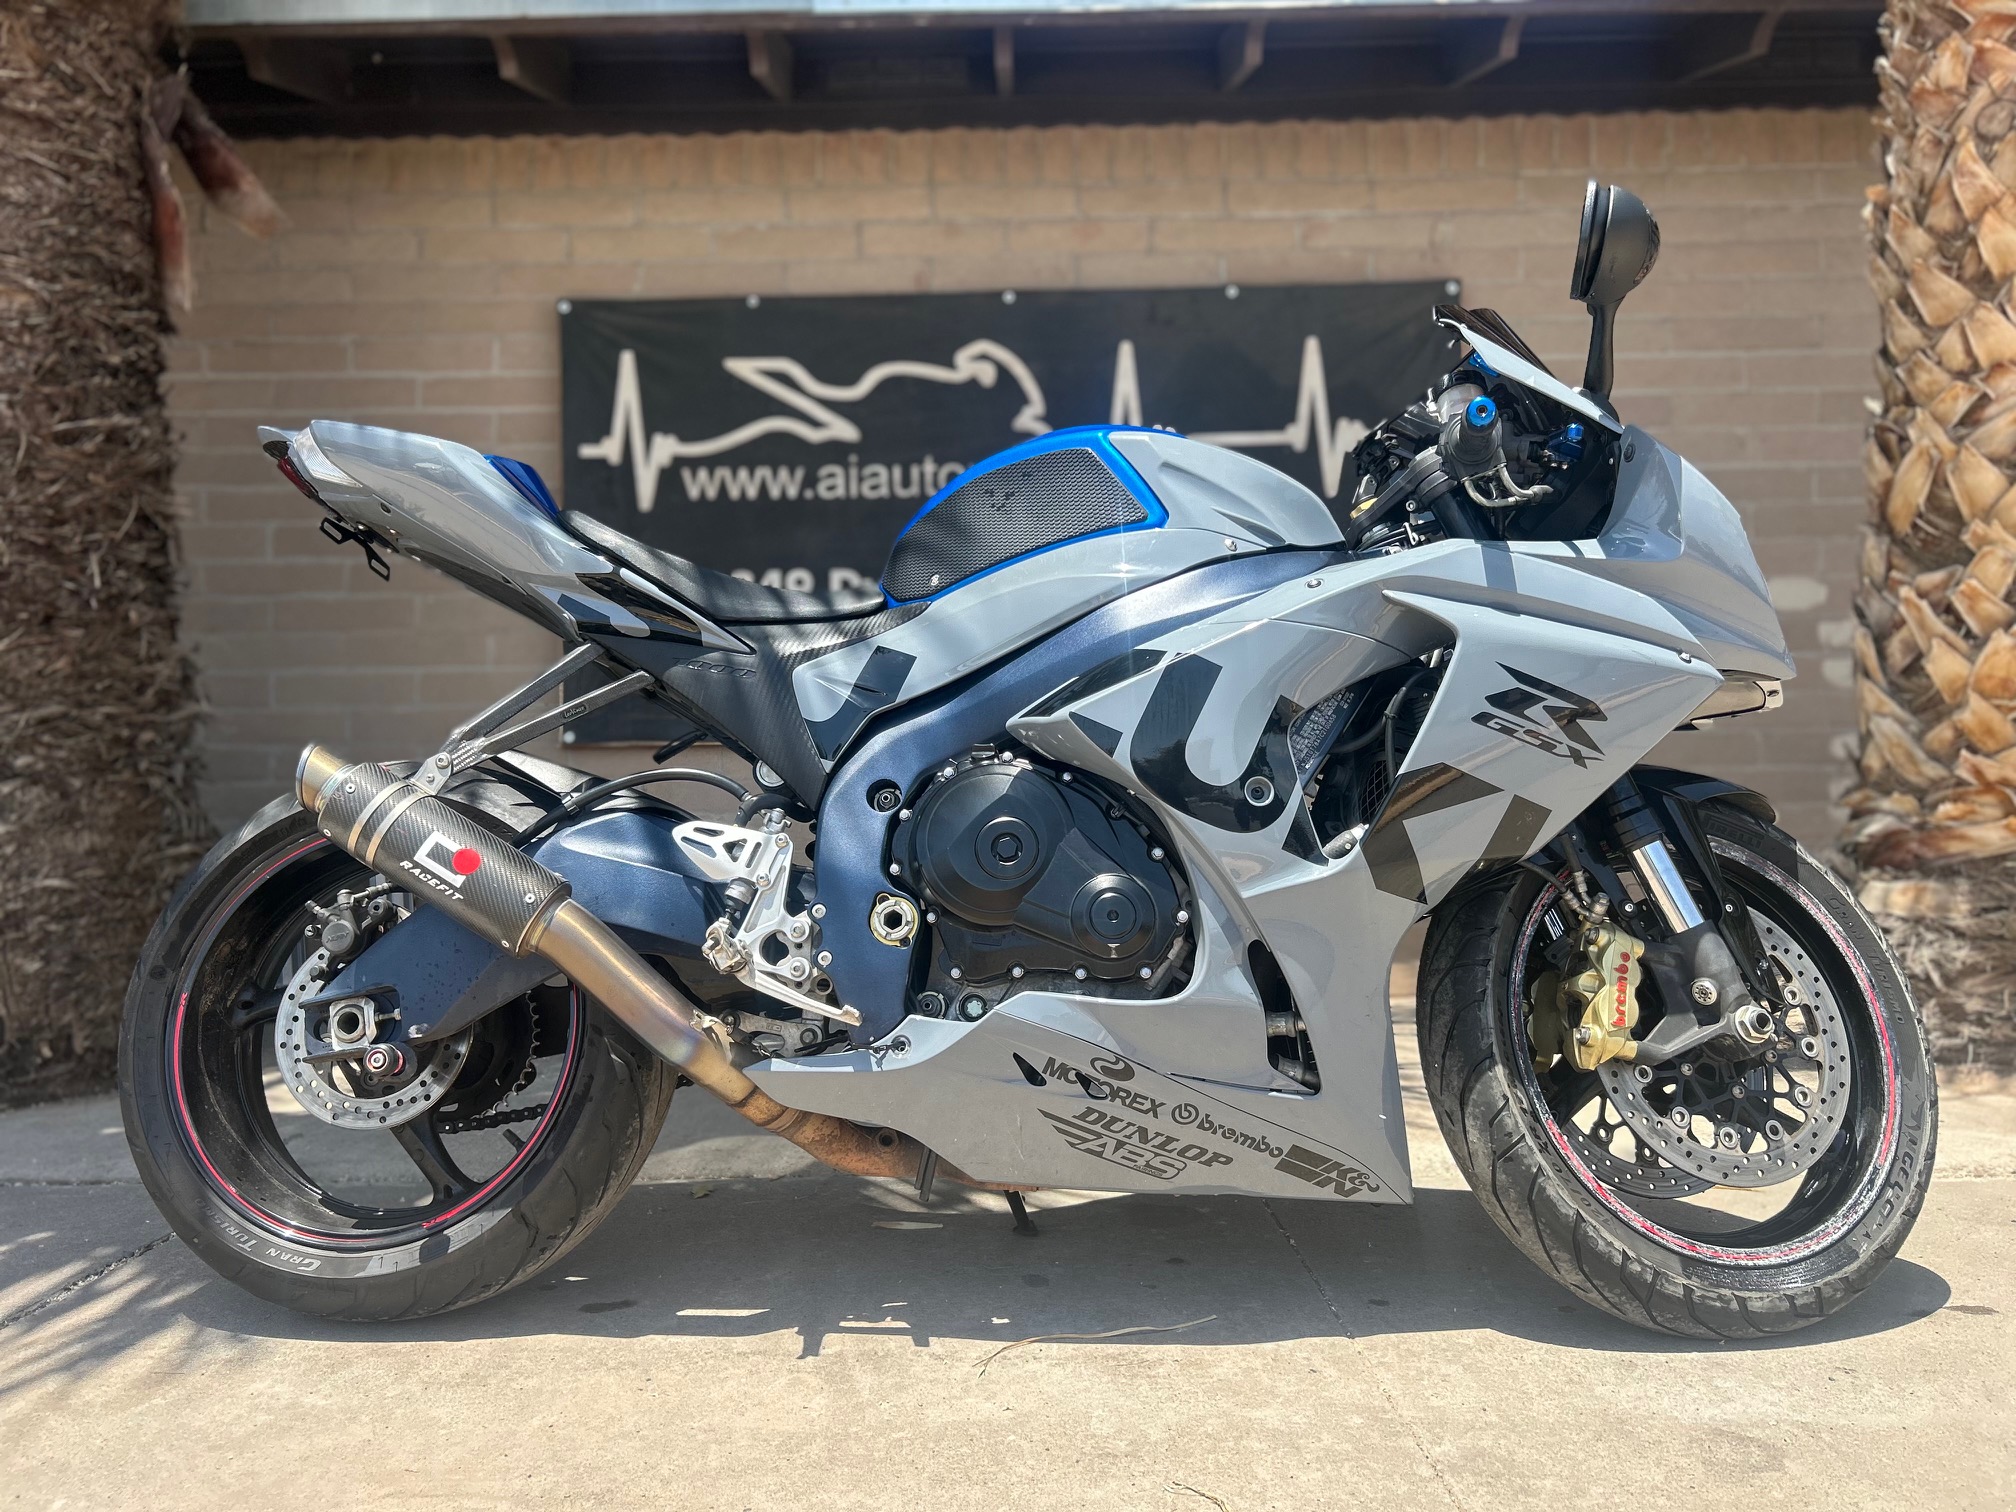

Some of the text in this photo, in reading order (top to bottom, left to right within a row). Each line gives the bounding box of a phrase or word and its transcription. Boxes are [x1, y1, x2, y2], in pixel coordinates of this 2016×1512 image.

[680, 453, 966, 500] www.aiauto
[400, 860, 464, 901] RACEFIT
[1611, 951, 1631, 1027] brembo
[1072, 1106, 1234, 1168] DUNLOP
[1196, 1113, 1284, 1158] brembo
[1072, 1136, 1188, 1181] ABS
[265, 1247, 322, 1271] GRAN
